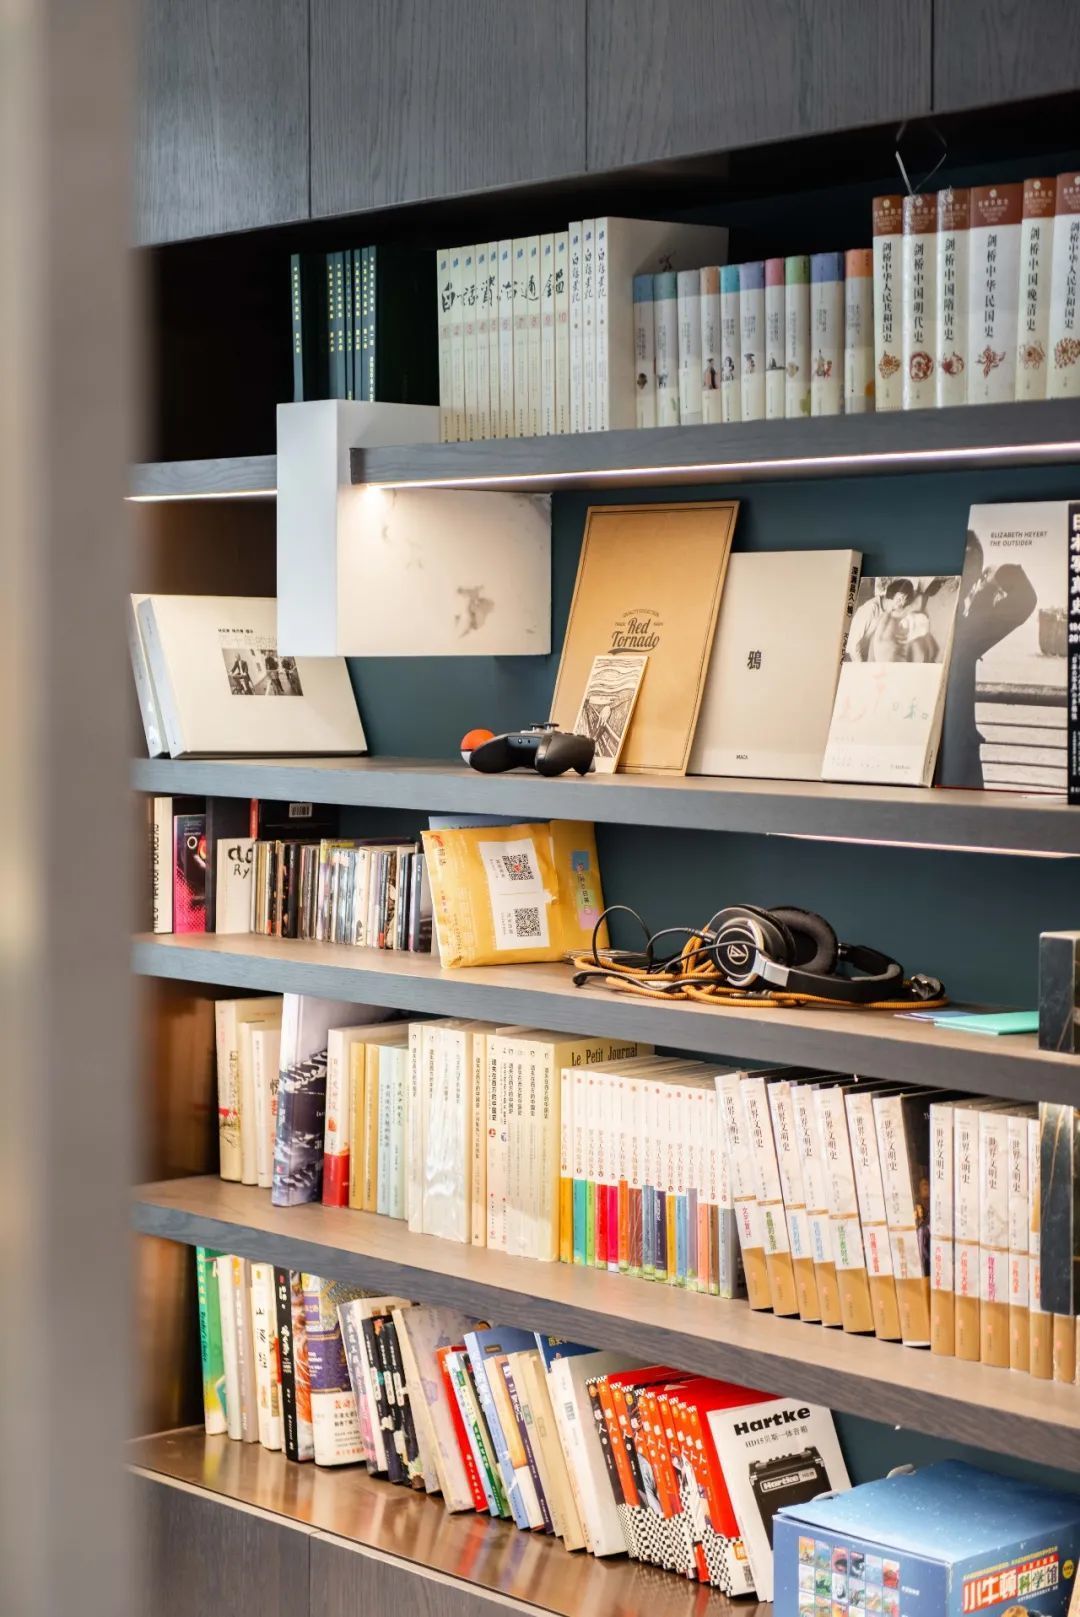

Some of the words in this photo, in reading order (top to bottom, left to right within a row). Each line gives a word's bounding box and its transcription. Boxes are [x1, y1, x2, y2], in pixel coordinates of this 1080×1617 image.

[881, 241, 893, 343] 剑桥中华人民共和国史
[913, 243, 925, 343] 剑桥中国明代史
[944, 237, 956, 341] 剑桥中国隋唐史
[984, 234, 998, 338] 剑桥中华民国史
[1026, 227, 1041, 332] 剑桥中国晚清史
[990, 531, 1023, 539] ELIZABETH
[1023, 530, 1048, 538] HEYERT
[1002, 539, 1033, 547] OUTSIDER
[611, 630, 660, 649] Tornado
[628, 617, 651, 634] Red
[571, 1051, 581, 1066] Le
[585, 1047, 604, 1064] Petit
[607, 1043, 638, 1060] Journal
[726, 1096, 740, 1145] 世界文明史
[749, 1099, 764, 1148] 世界文明史
[777, 1102, 791, 1152] 世界文明史
[799, 1106, 813, 1157] 世界文明史
[824, 1109, 838, 1160] 世界文明史
[856, 1116, 869, 1167] 世界文明史
[884, 1119, 898, 1172] 世界文明史
[936, 1128, 944, 1181] 世界文明史
[961, 1132, 970, 1185] 世界文明史
[988, 1136, 998, 1190] 世界文明史
[1012, 1139, 1021, 1193] 世界文明史
[733, 1407, 811, 1436] Hartke
[763, 1474, 800, 1492] Hartke
